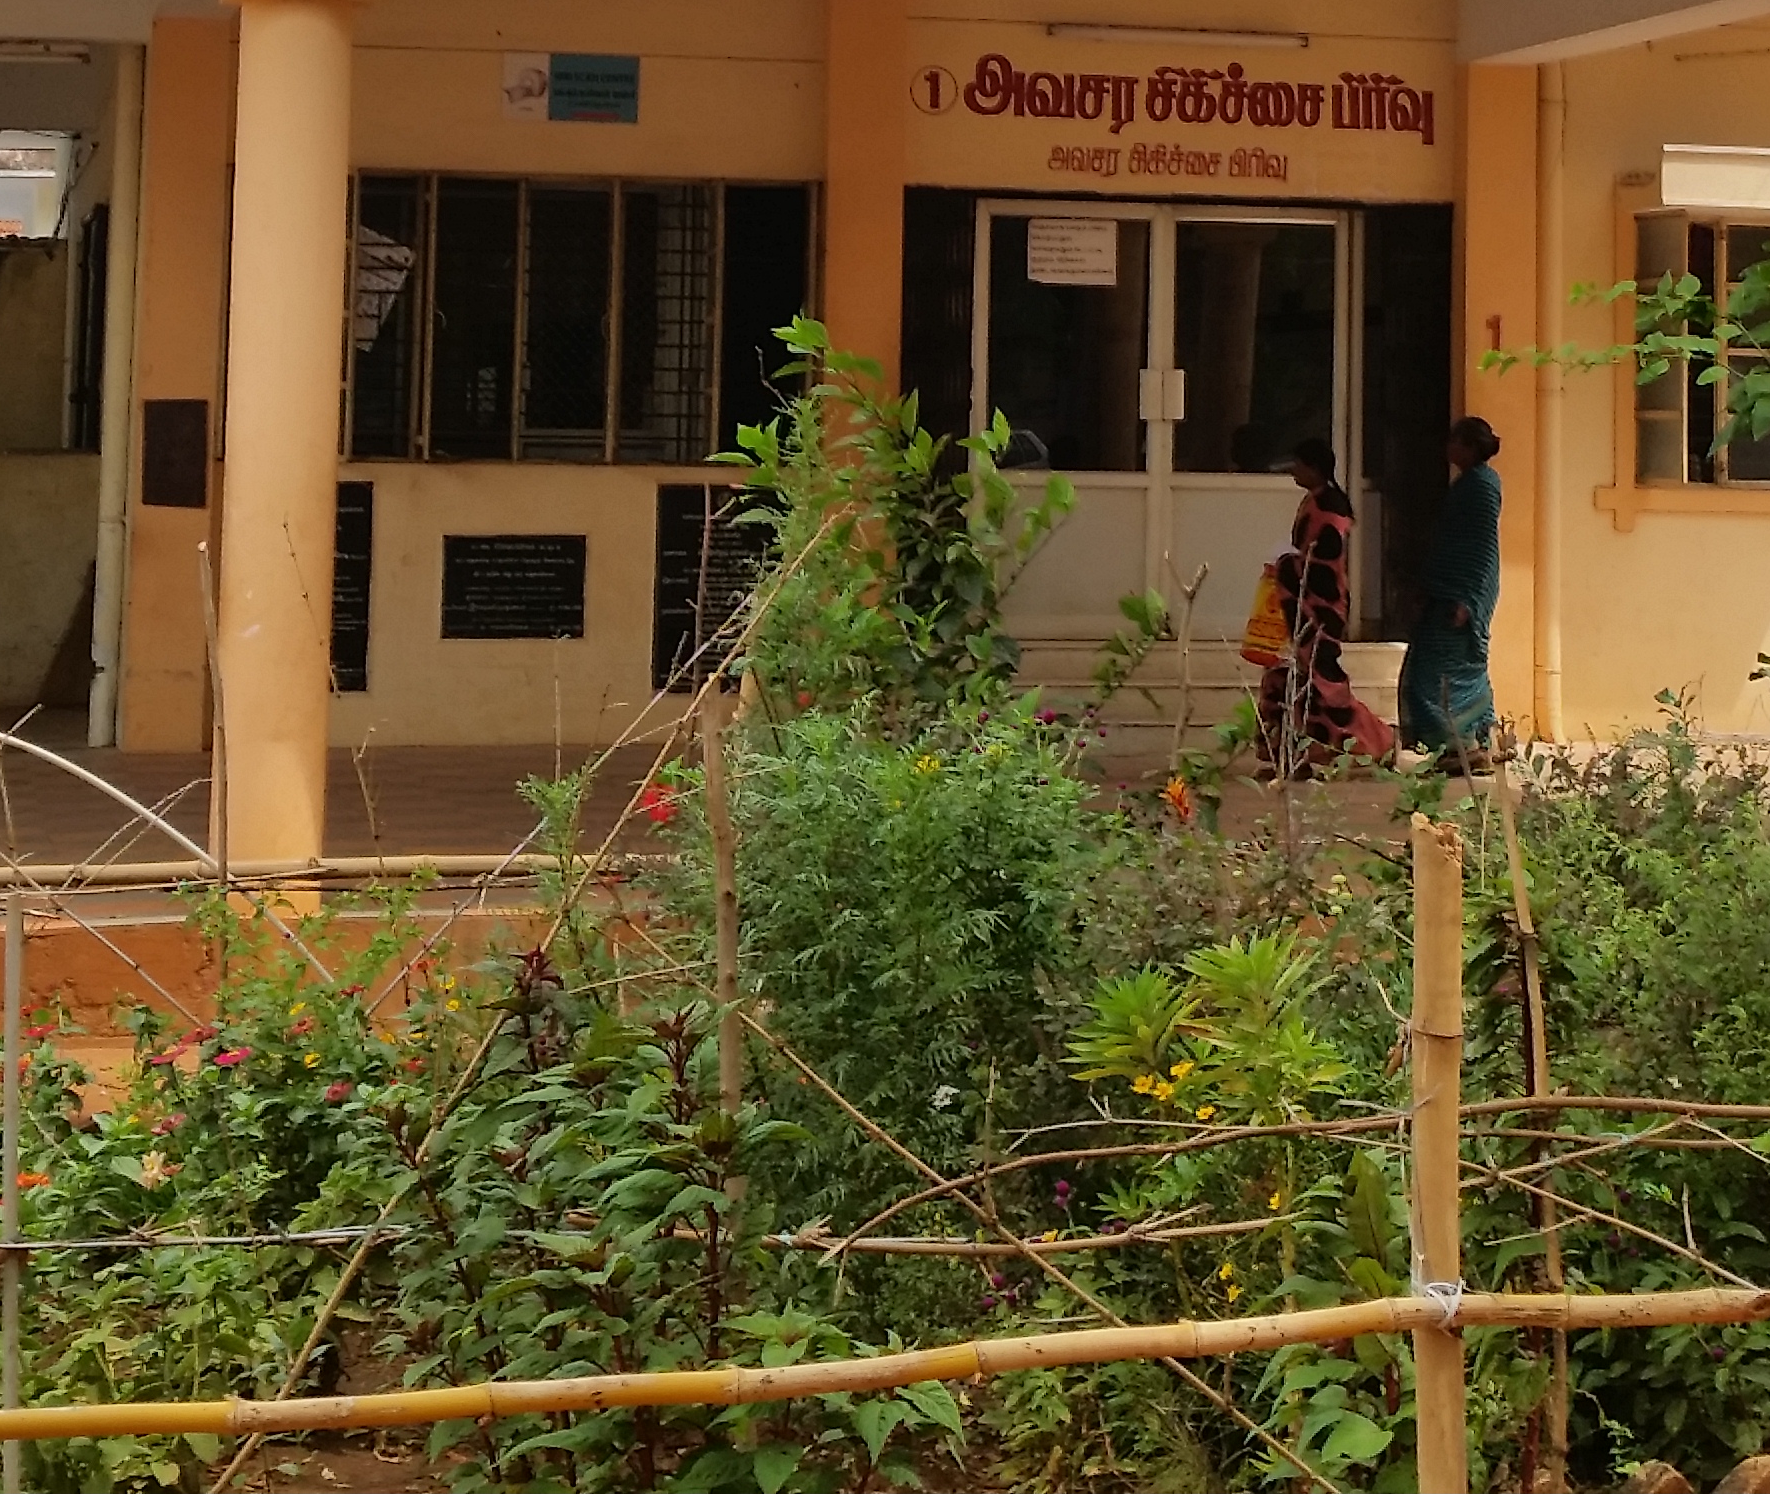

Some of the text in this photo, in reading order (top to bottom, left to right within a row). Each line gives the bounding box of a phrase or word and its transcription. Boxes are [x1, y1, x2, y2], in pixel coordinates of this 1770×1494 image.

[964, 53, 1139, 135] அவசர
[1145, 62, 1325, 128] சிகிச்சை
[1331, 71, 1435, 145] பிரிவு
[1048, 142, 1288, 182] அவசர சிகிச்சை பிரிவு
